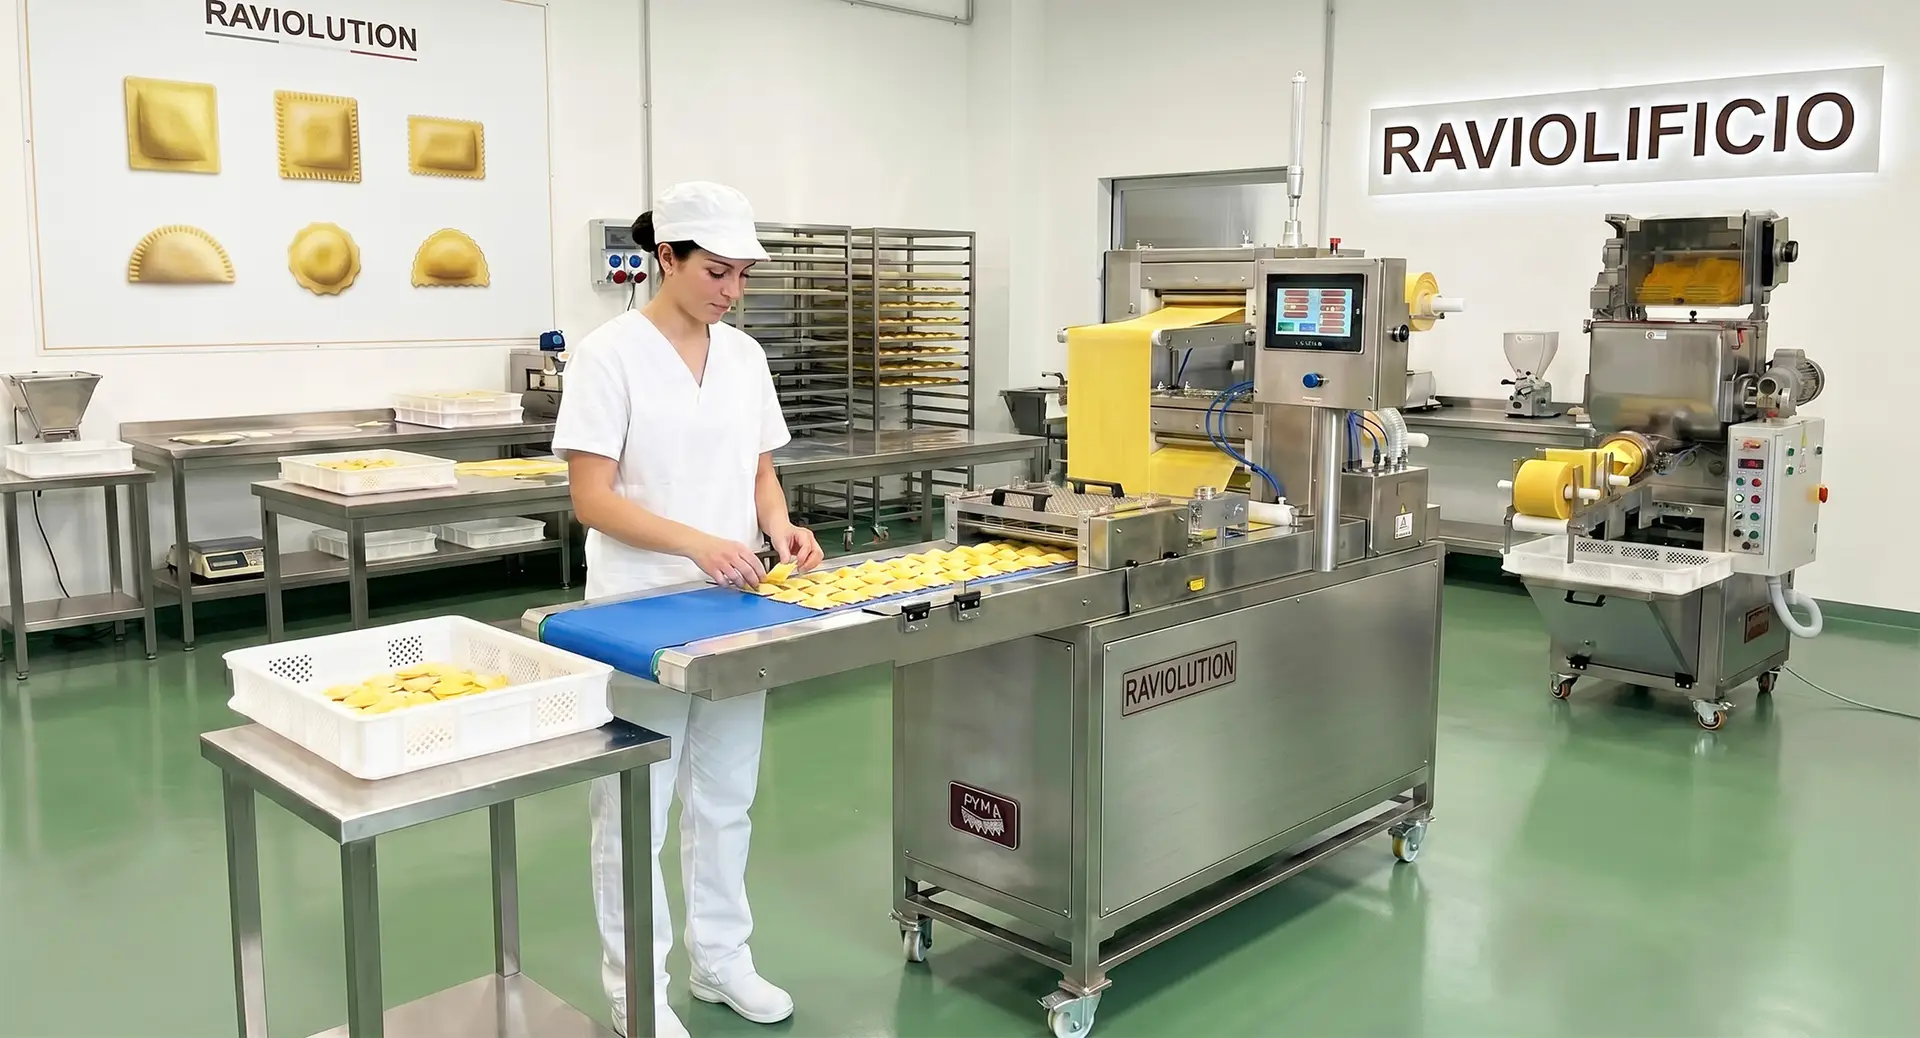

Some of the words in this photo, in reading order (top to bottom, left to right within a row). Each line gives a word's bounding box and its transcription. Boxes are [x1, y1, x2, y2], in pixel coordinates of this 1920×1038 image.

[205, 0, 418, 51] RAVIOLUTION
[1383, 91, 1855, 175] RAVIOLIFICIO
[1125, 649, 1234, 707] RAVIOLUTION
[963, 793, 1002, 819] PYMA
